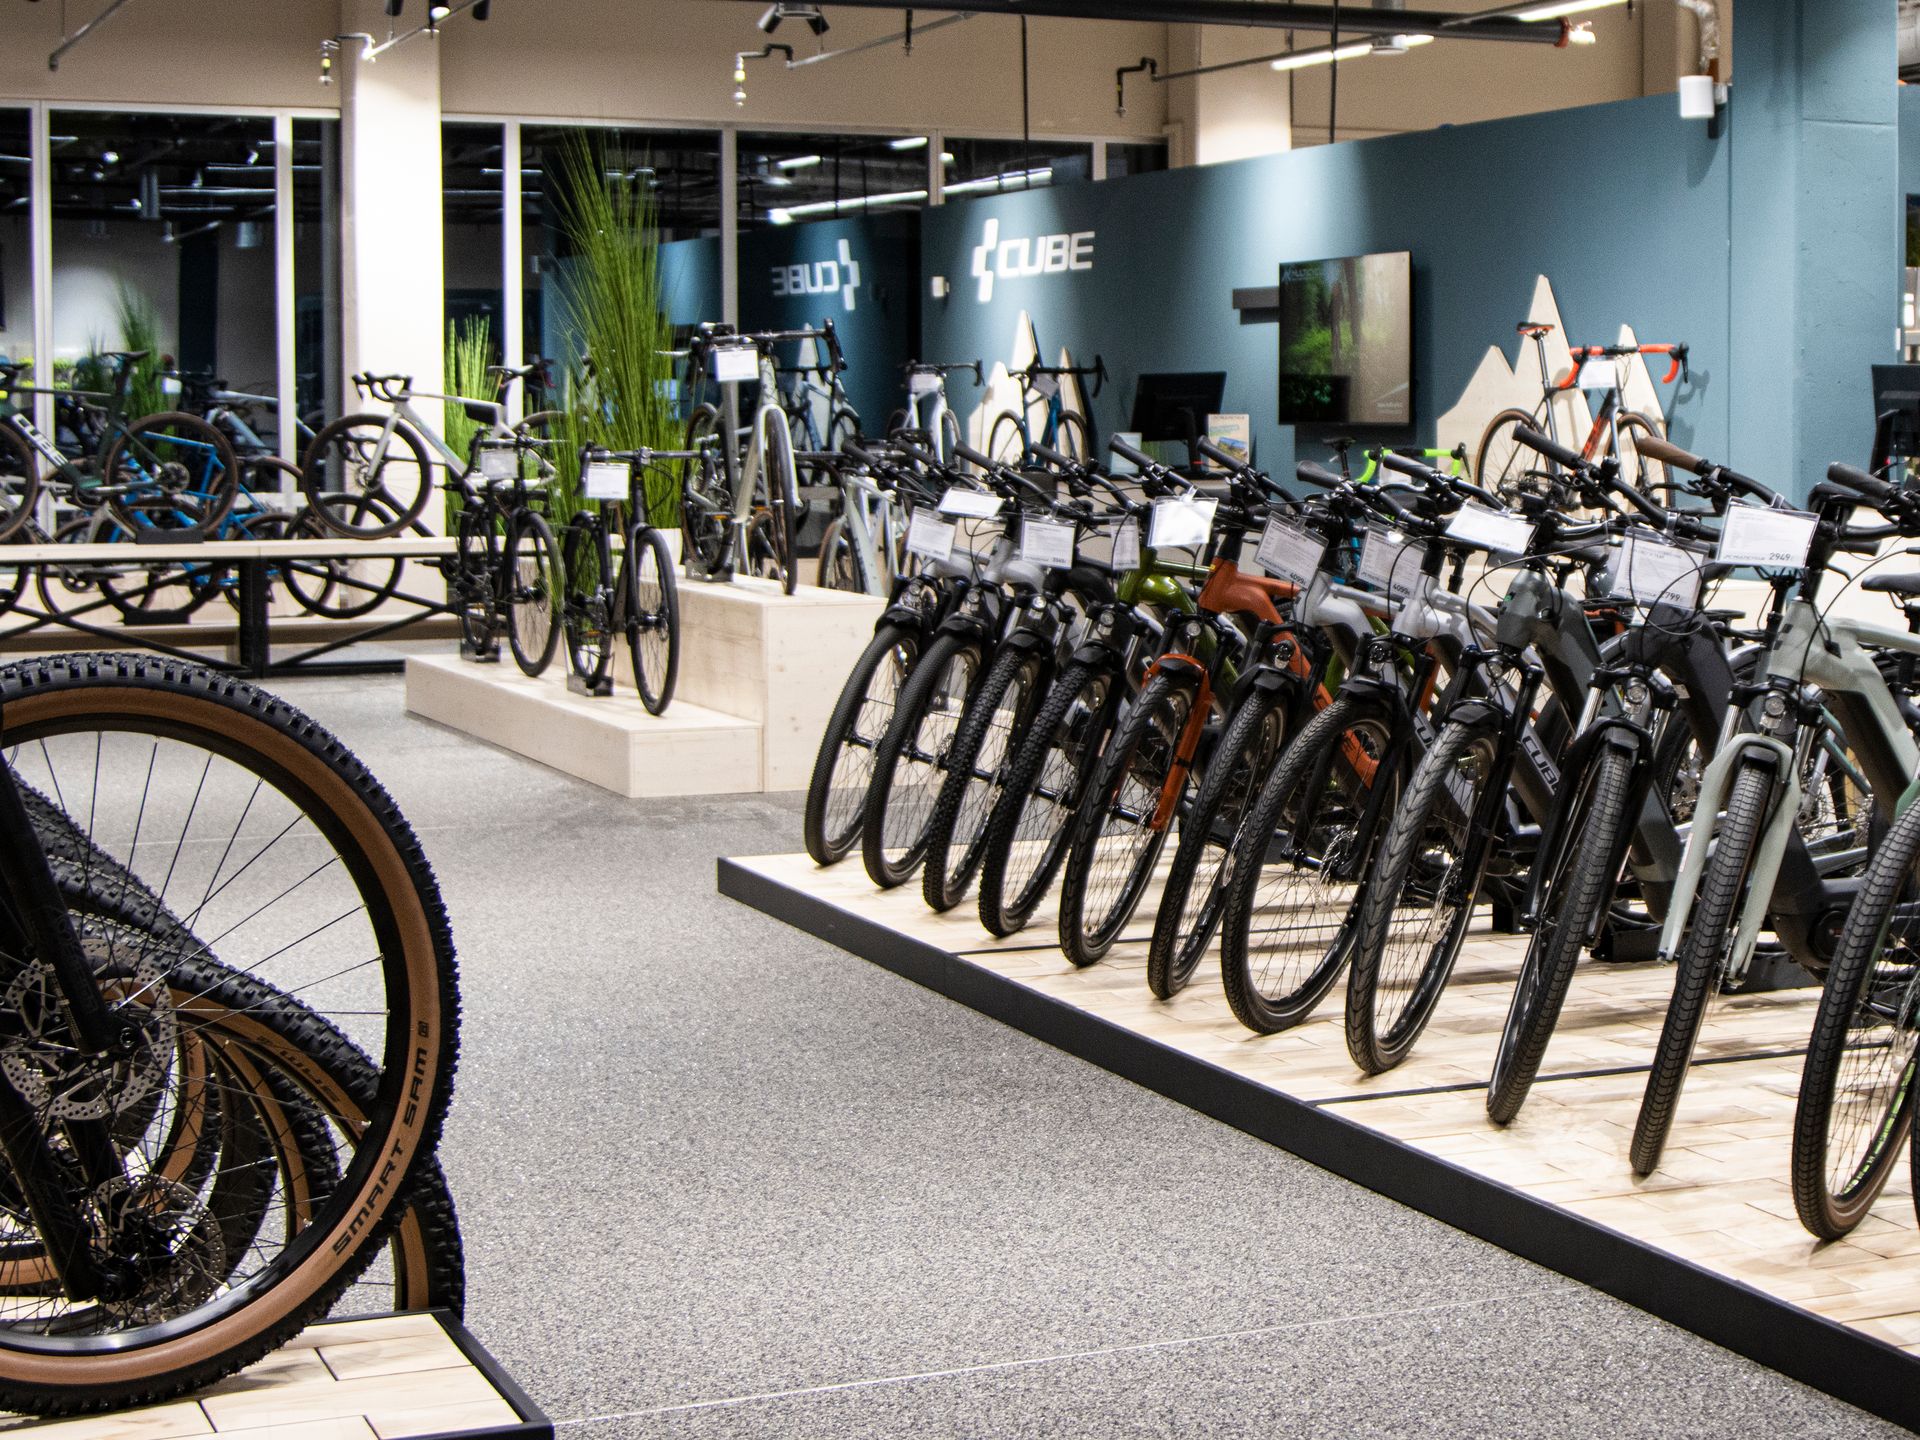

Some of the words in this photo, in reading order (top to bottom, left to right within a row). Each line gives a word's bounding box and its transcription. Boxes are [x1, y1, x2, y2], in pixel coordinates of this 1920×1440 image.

[997, 231, 1096, 279] CUBE
[11, 413, 69, 467] CUBE
[332, 1138, 404, 1256] SMART
[403, 1048, 427, 1128] SAM
